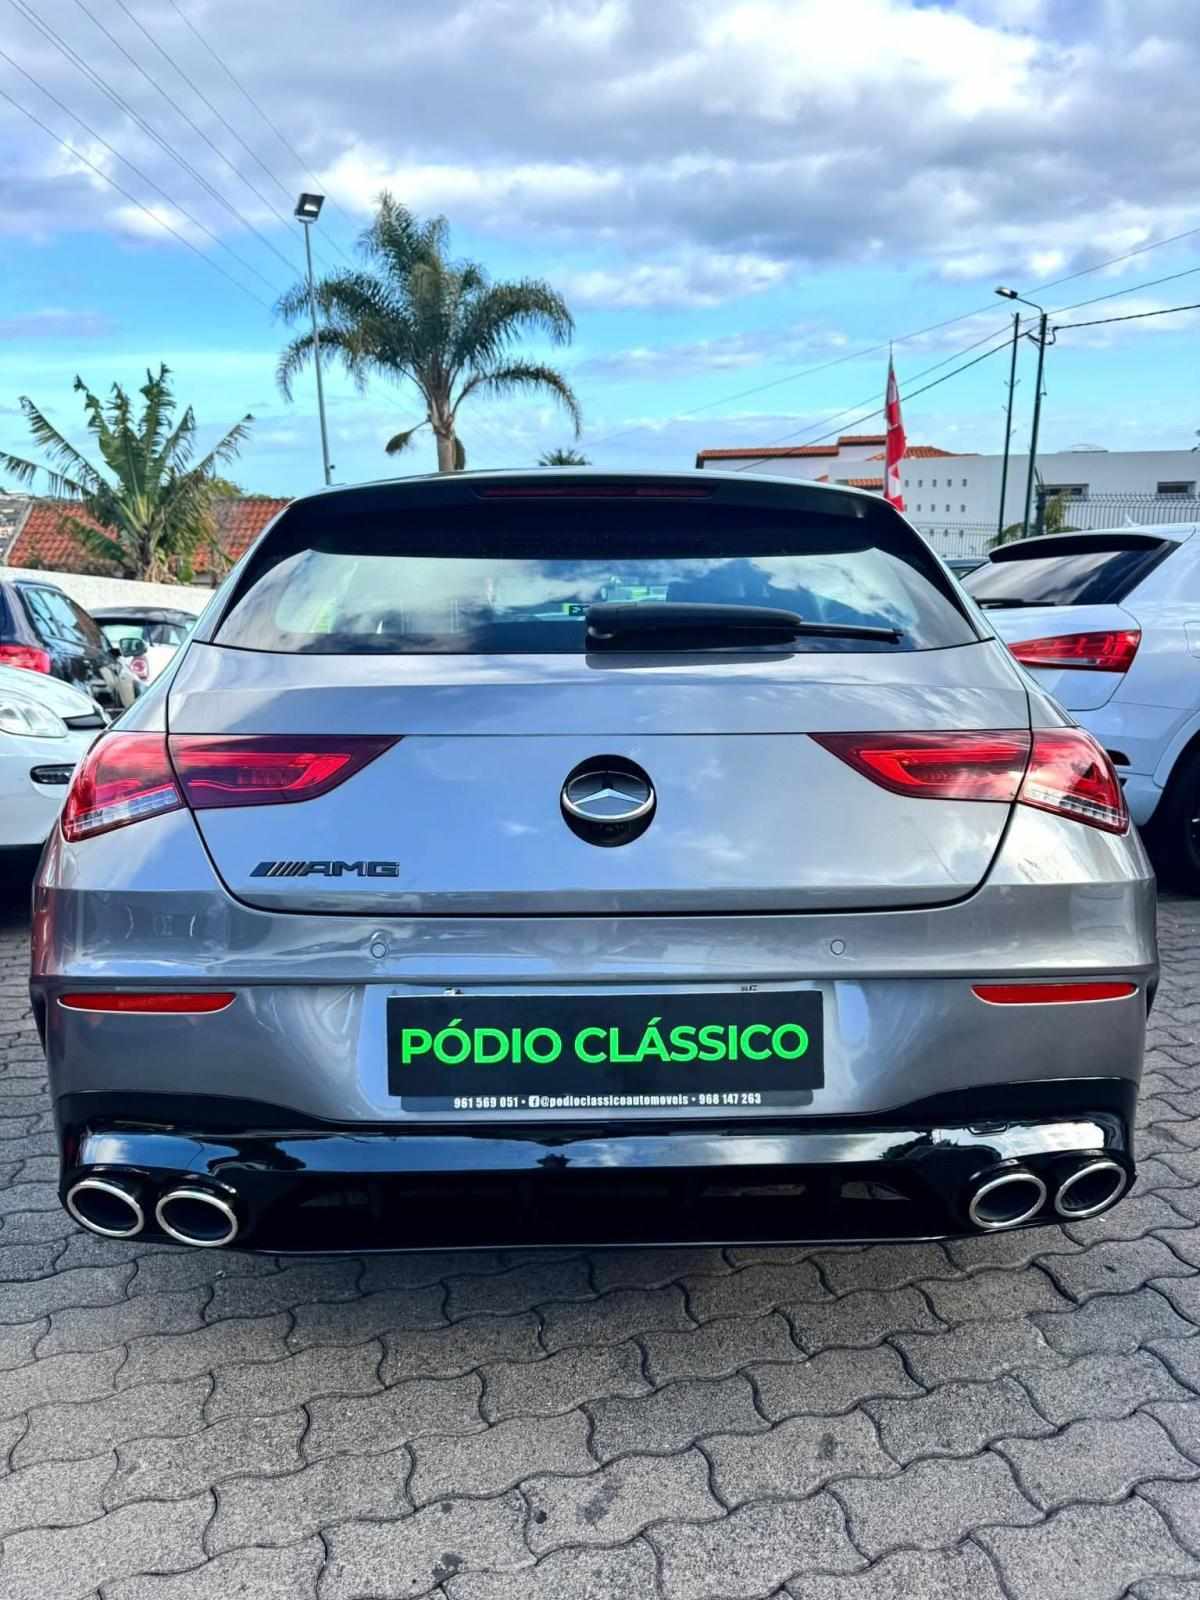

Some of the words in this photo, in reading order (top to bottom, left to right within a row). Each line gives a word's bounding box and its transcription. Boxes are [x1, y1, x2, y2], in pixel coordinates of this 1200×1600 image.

[301, 861, 399, 877] AMG
[402, 1018, 562, 1064] PÓDIO
[574, 1016, 808, 1063] CLÁSSICO
[454, 1097, 473, 1108] 961
[500, 1097, 519, 1107] 051
[699, 1093, 720, 1105] 968
[723, 1093, 739, 1104] 147
[741, 1093, 762, 1104] 263
